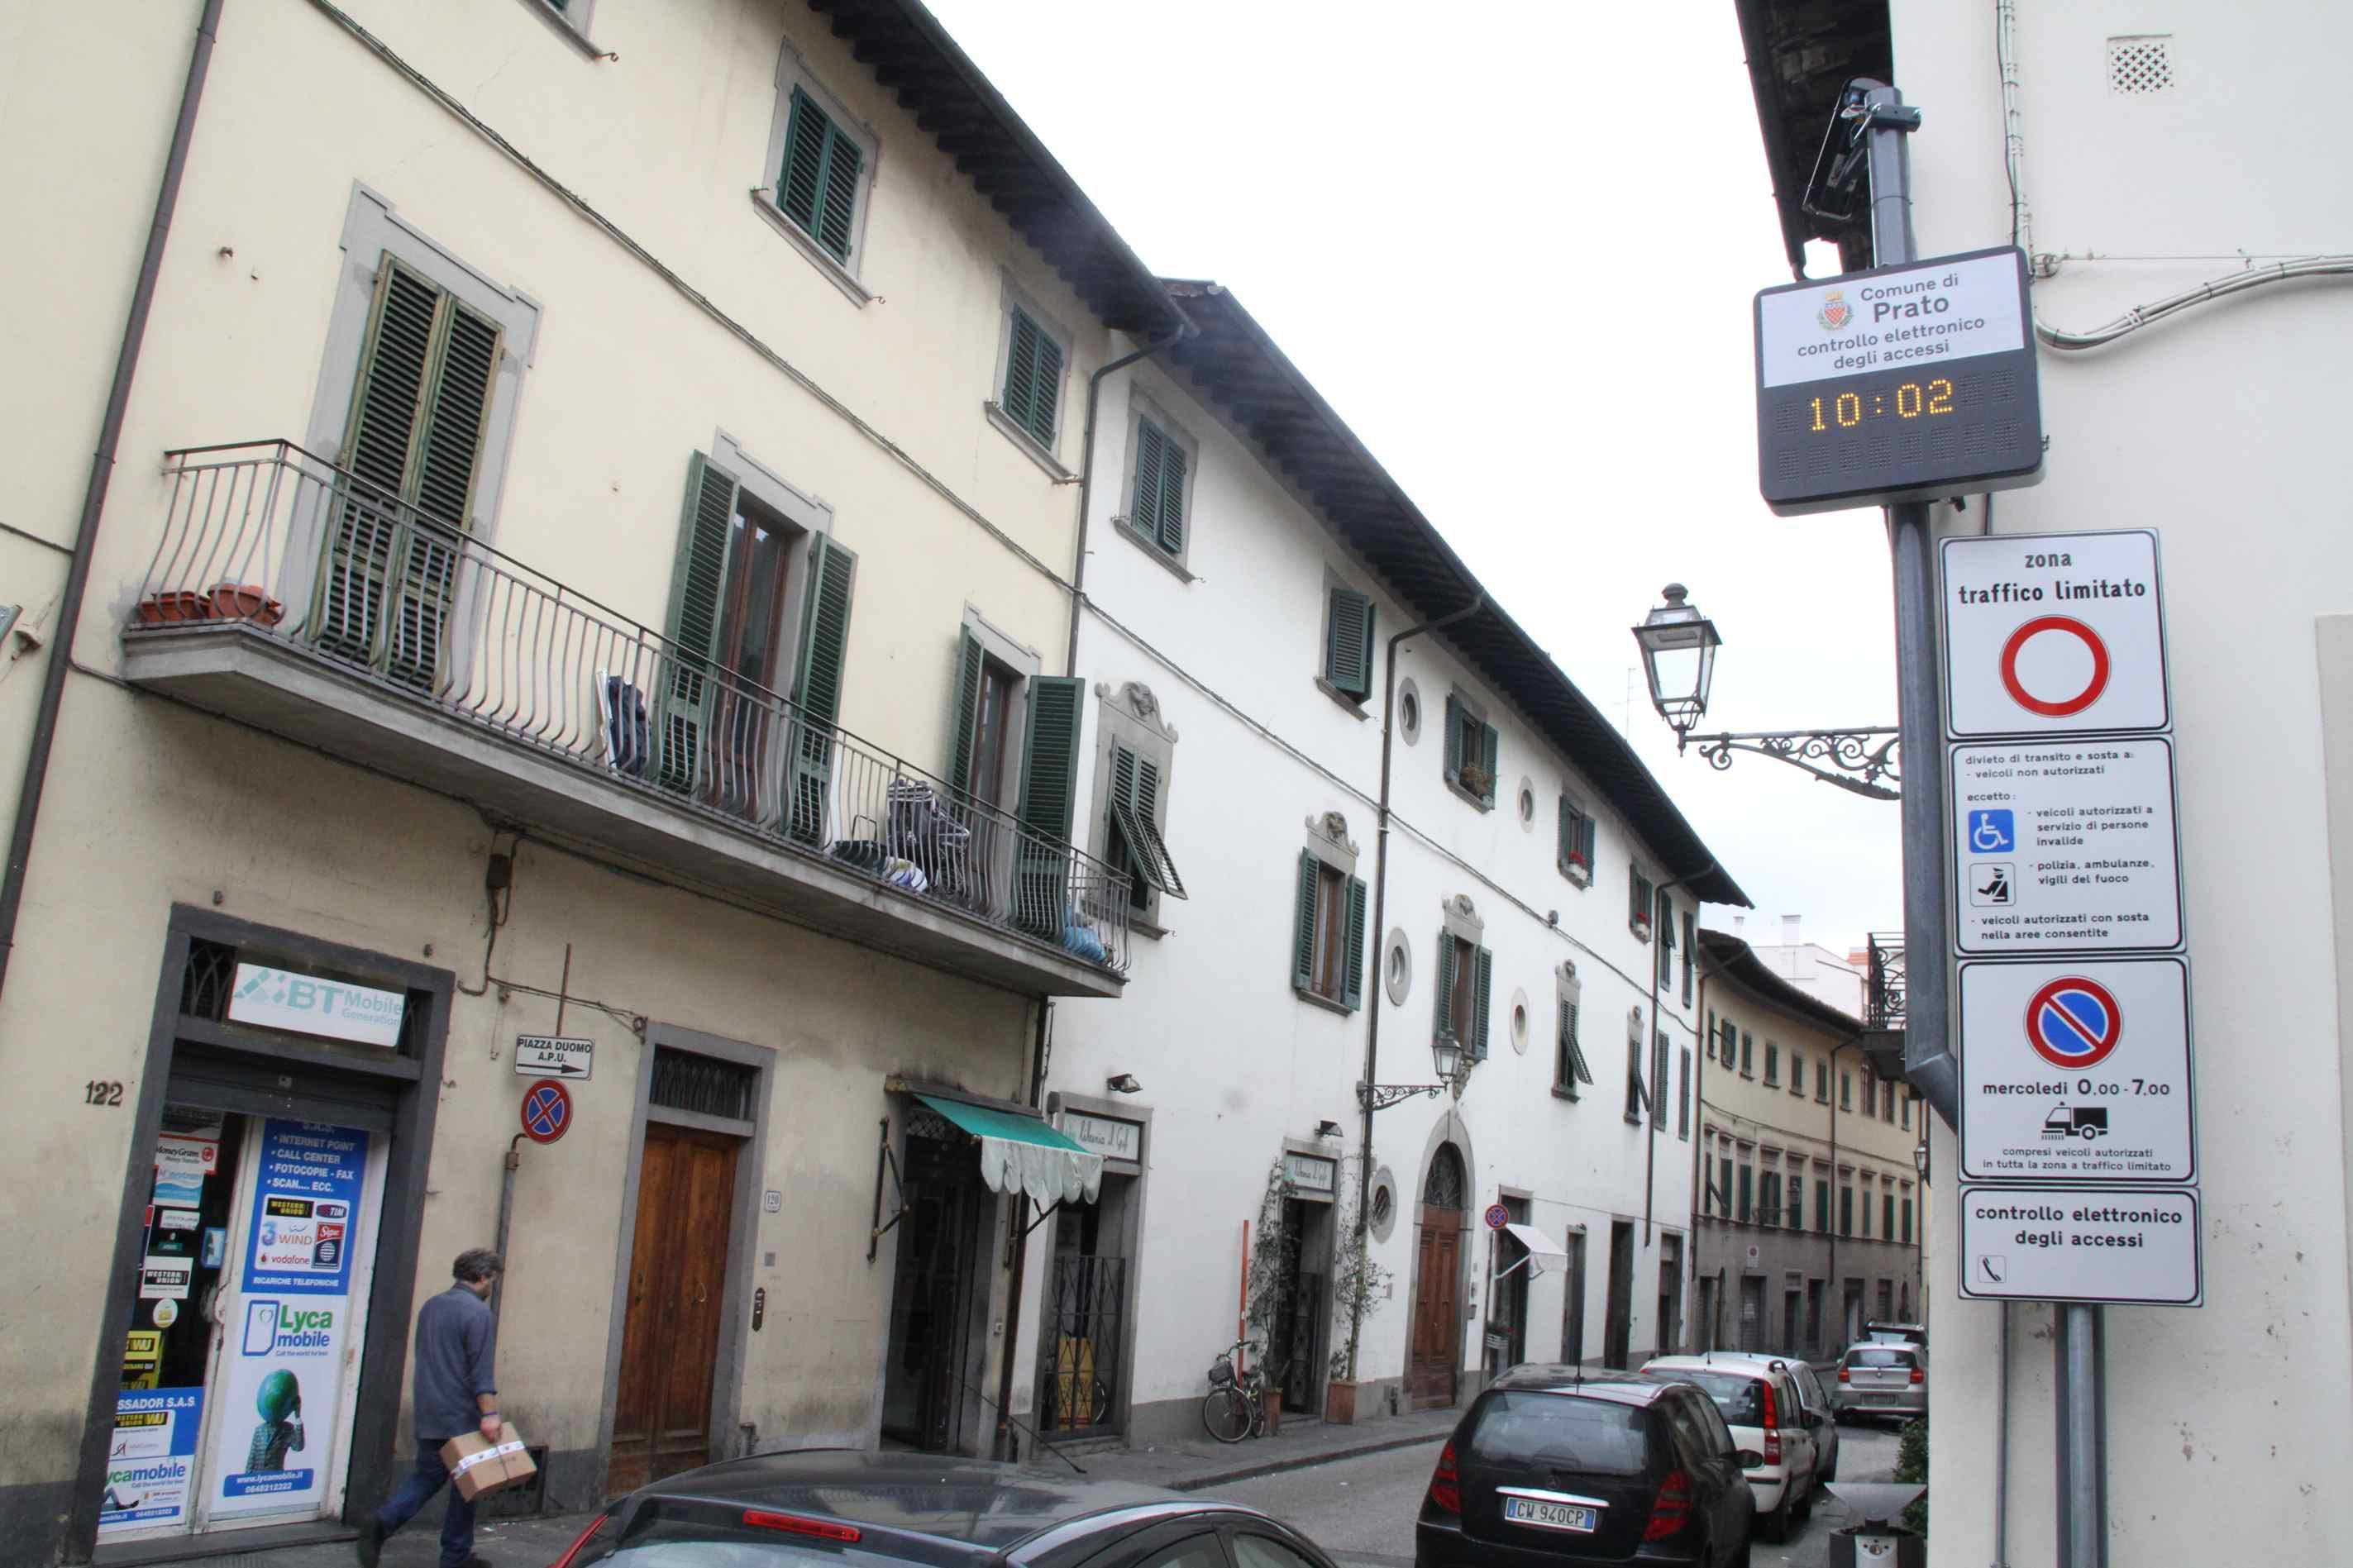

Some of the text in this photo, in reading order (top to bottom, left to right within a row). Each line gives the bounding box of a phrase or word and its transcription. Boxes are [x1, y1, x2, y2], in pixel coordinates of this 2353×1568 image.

[1860, 273, 1959, 302] Comune di
[1873, 295, 1950, 323] Prato
[1797, 317, 1985, 357] controllo elettronico
[1833, 339, 1950, 371] degli accessi
[2025, 553, 2072, 569] zona
[1959, 579, 2145, 604] traffico limitato
[1965, 755, 2005, 765] divieto
[2009, 754, 2020, 763] di
[2026, 752, 2071, 762] transito
[2087, 751, 2119, 760] sosta
[2123, 751, 2135, 760] a:
[1975, 769, 2012, 779] veicoli
[2017, 769, 2039, 778] non
[2043, 765, 2105, 776] autorizzati
[2036, 807, 2074, 817] veicoli
[2079, 805, 2142, 816] autorizzati
[2036, 821, 2149, 832] servizio di persone
[2036, 836, 2084, 846] invalide
[2038, 873, 2129, 886] vigili del fuoco
[1981, 915, 2020, 925] veicoli
[2024, 913, 2087, 924] autorizzati
[2091, 913, 2112, 922] con
[2117, 913, 2149, 922] sosta
[1981, 927, 2108, 940] nella aree consentite
[288, 979, 345, 1014] BT
[344, 991, 403, 1016] Mobile
[516, 1037, 591, 1053] PIAZZA DUOMO
[85, 1079, 123, 1107] 122
[279, 1136, 356, 1151] INTERNET POINT
[277, 1149, 341, 1164] CALL CENTER
[2002, 1147, 2154, 1158] compresi veicoli autorizzati
[274, 1163, 330, 1178] FOTOCOPIE
[336, 1169, 355, 1180] FAX
[1983, 1160, 2171, 1171] in tutta la zona a traffico limitato
[1975, 1206, 2183, 1223] controllo elettronico
[279, 1234, 313, 1246] WIND
[2015, 1230, 2143, 1248] degli accessi
[271, 1255, 311, 1265] vodafone
[279, 1304, 333, 1333] Lyca
[277, 1331, 330, 1347] mobile
[1516, 1503, 1584, 1525] CW 940CP
